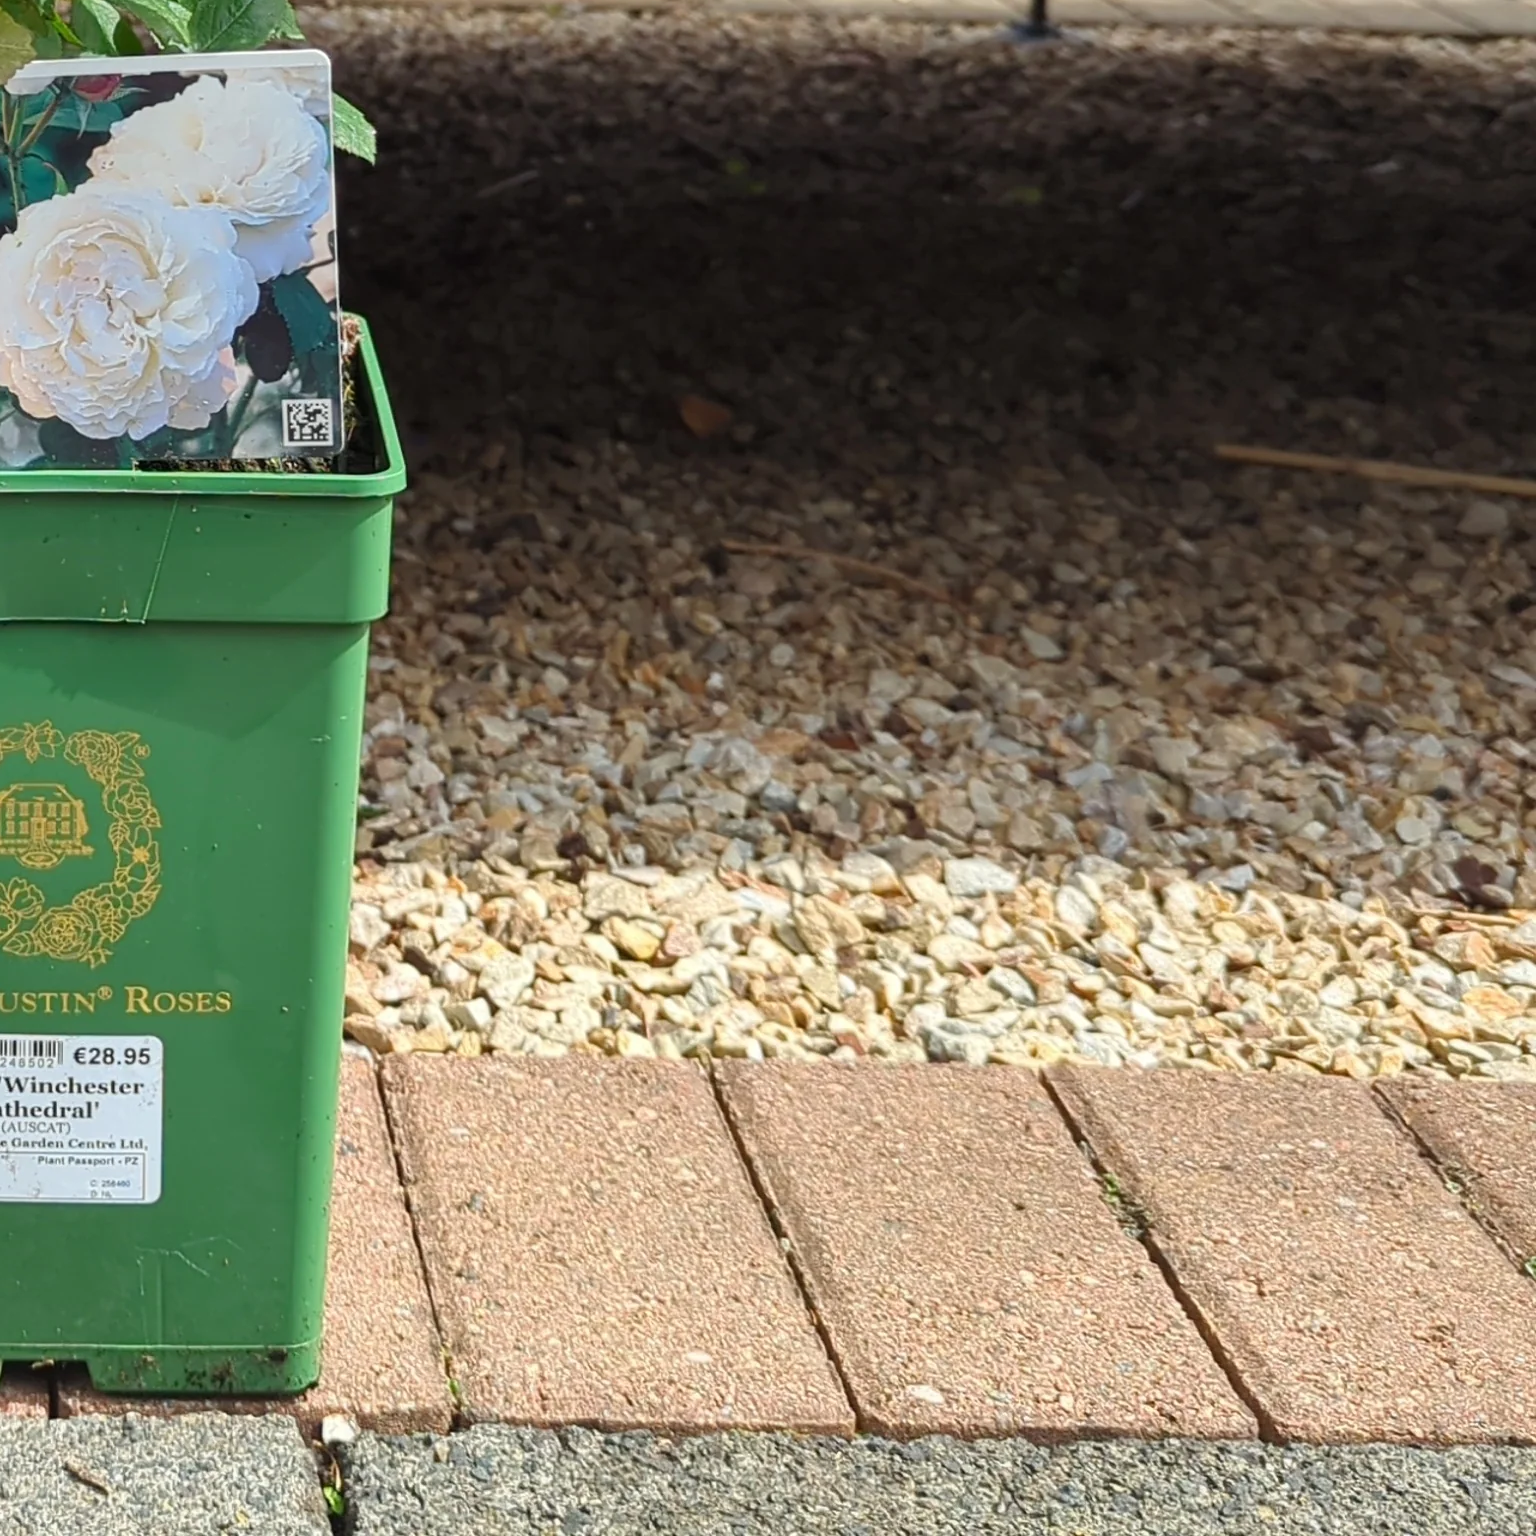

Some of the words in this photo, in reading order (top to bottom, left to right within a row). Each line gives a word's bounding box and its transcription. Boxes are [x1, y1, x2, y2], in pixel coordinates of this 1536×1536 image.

[124, 985, 233, 1014] ROSES
[73, 1047, 151, 1065] €28.95
[1, 1121, 71, 1135] (AUSCAT)
[11, 1135, 64, 1149] Garden
[68, 1138, 116, 1150] Centre
[38, 1155, 65, 1165] Plant
[67, 1156, 115, 1167] Passport
[125, 1157, 139, 1165] PZ
